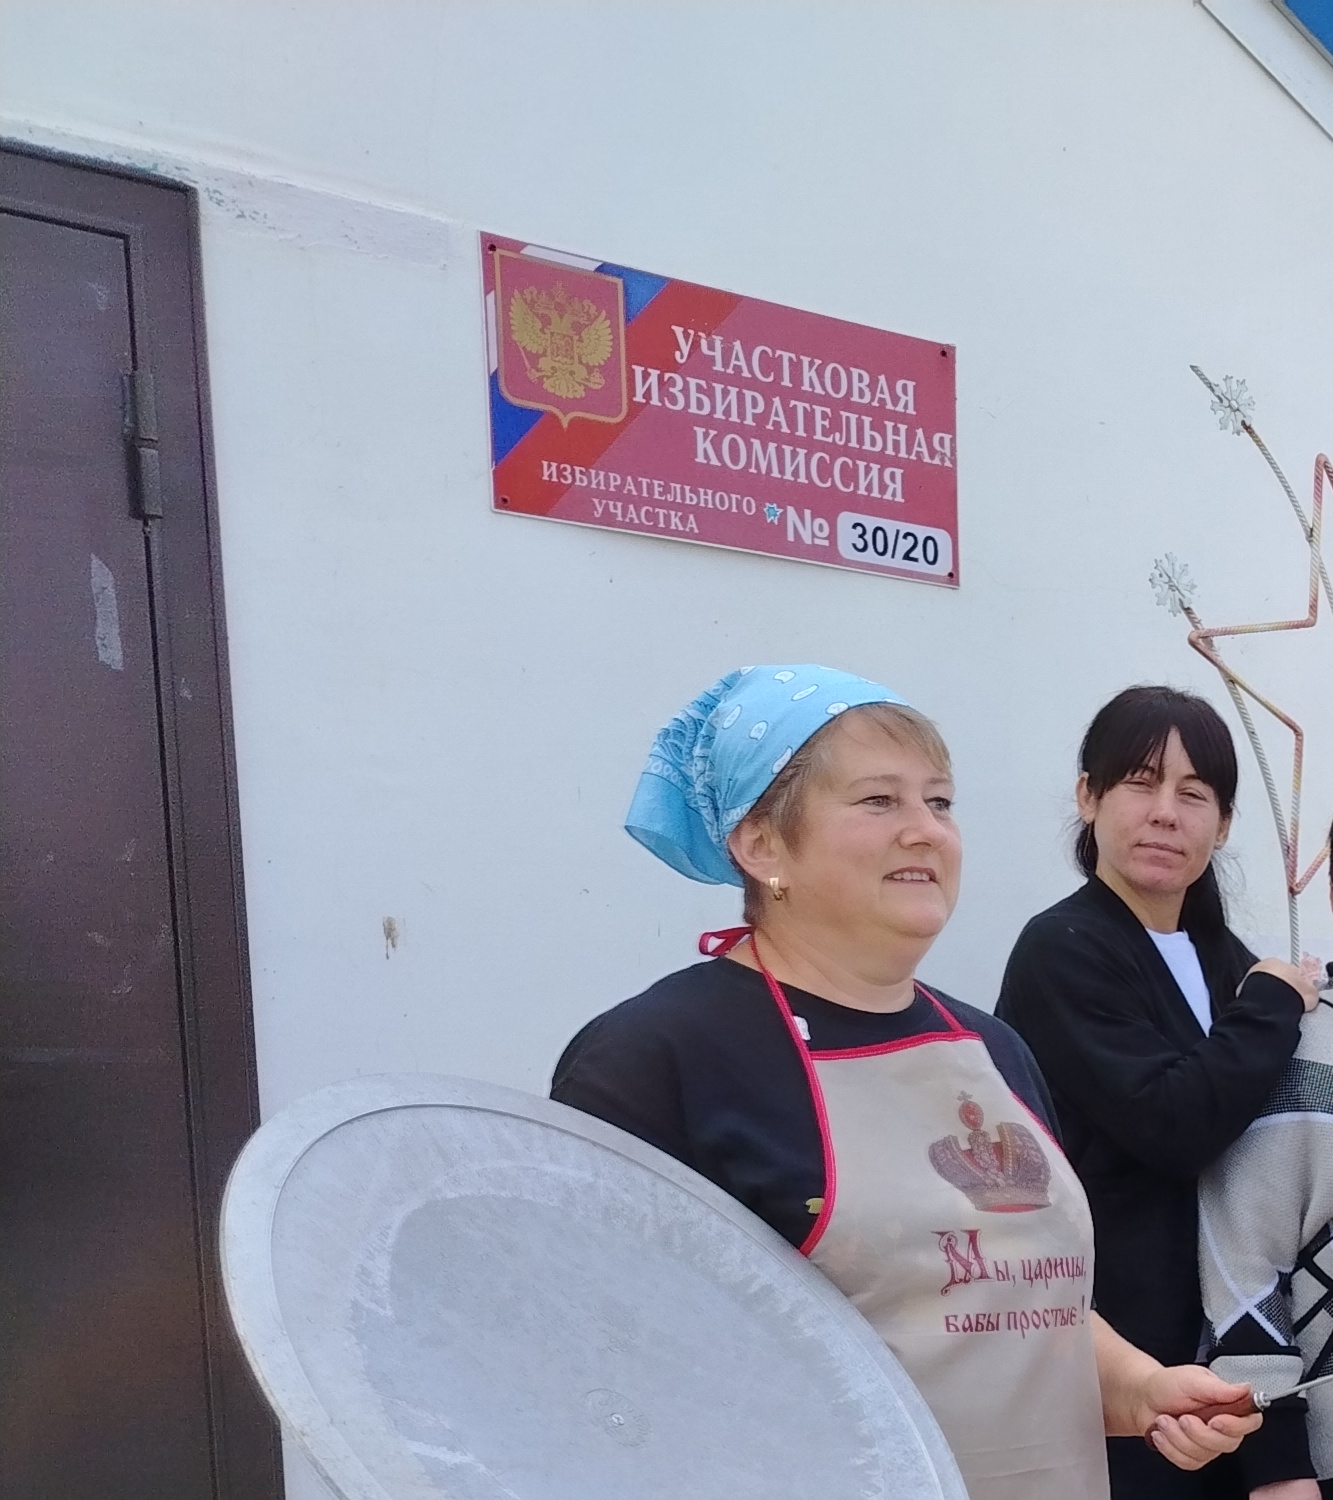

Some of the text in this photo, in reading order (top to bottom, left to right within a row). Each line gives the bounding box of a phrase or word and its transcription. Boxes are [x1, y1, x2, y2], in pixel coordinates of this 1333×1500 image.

[671, 326, 916, 415] УЧАСТКОВАЯ
[632, 366, 954, 468] ИЗБИРАТЕЛЬНАЯ
[541, 460, 756, 516] ИЗБИРАТЕЛЬНОГО
[694, 427, 905, 503] КОМИССИЯ
[592, 498, 699, 534] УЧАСТКА
[787, 508, 939, 566] № 30/20
